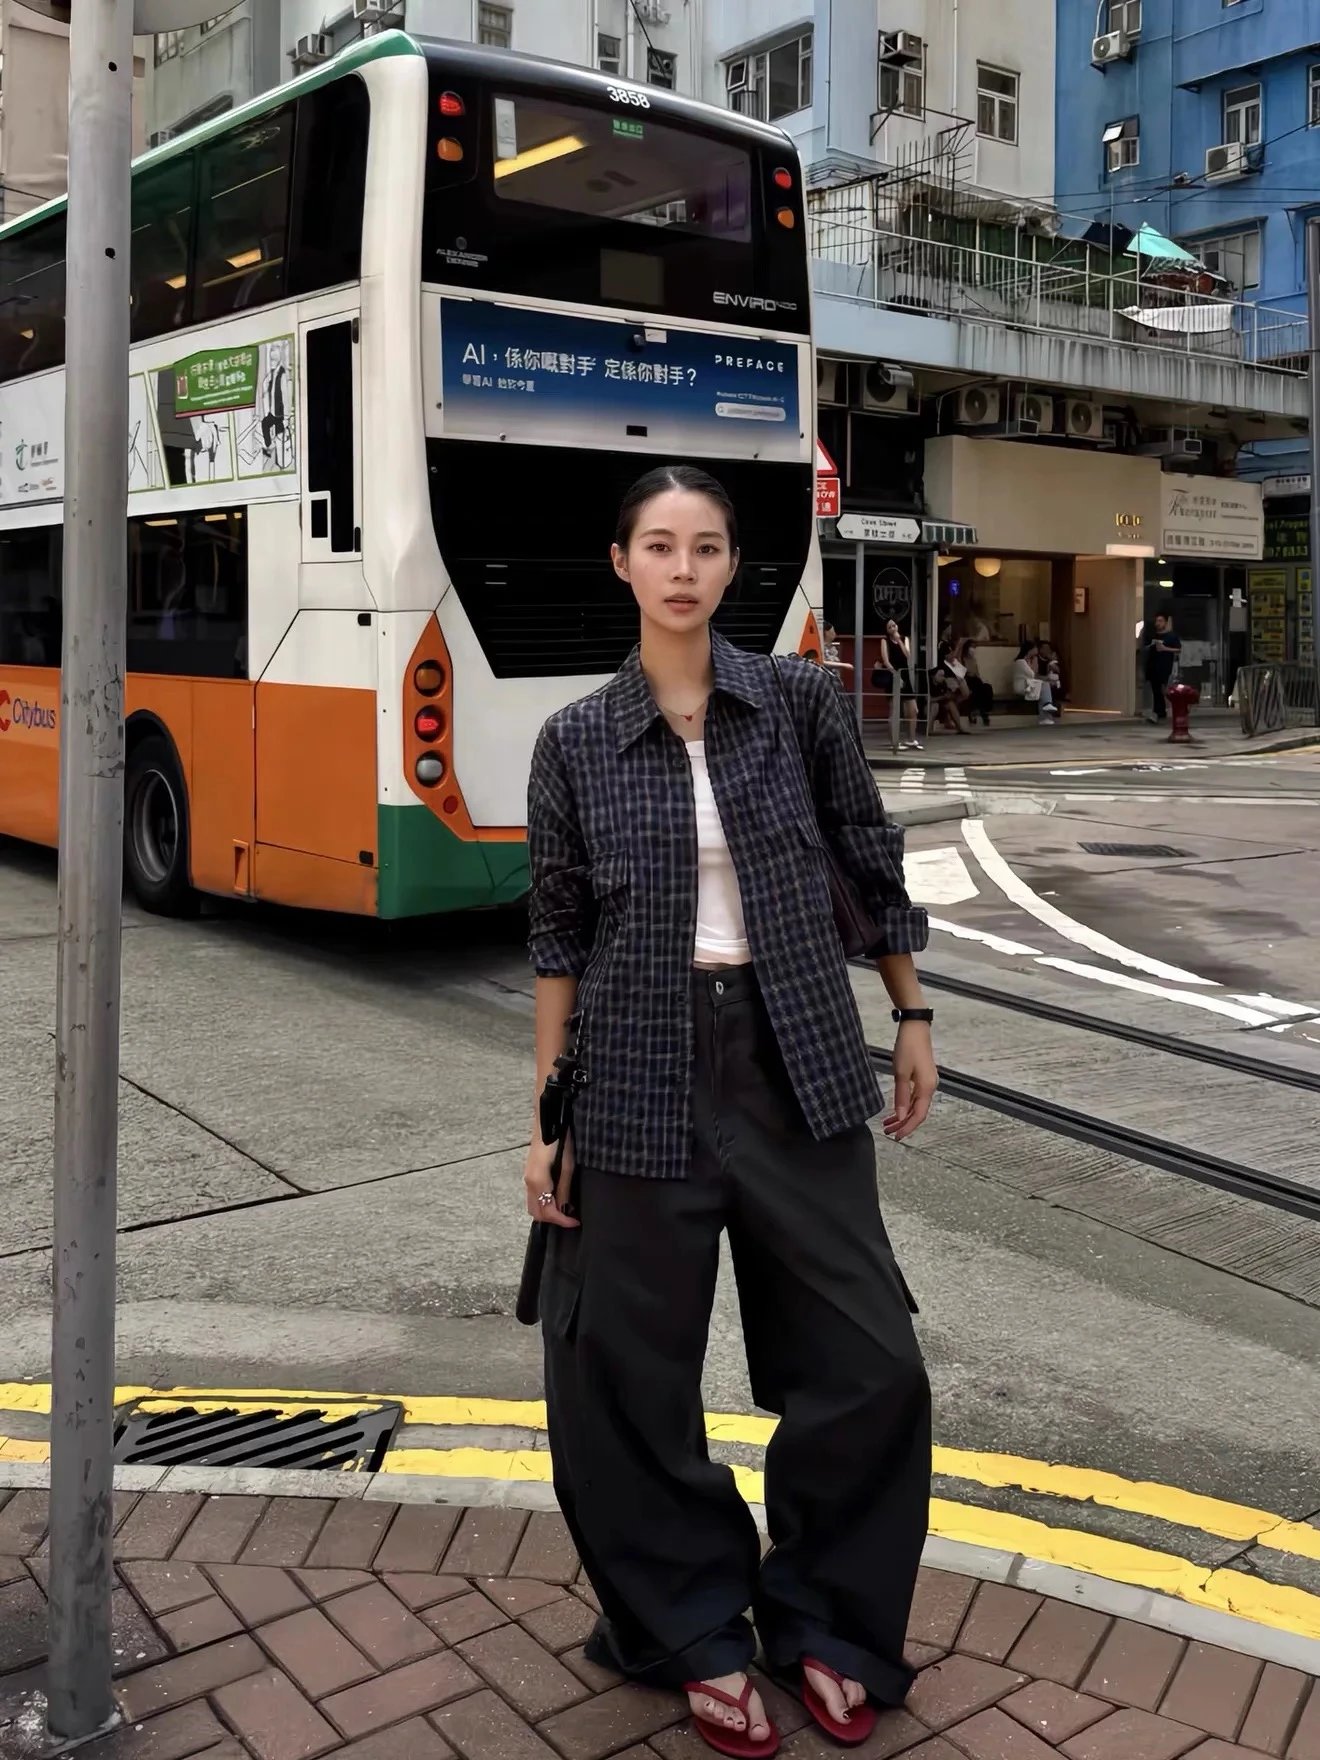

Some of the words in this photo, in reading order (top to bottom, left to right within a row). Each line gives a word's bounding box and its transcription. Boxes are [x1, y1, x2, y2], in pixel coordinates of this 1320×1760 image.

[606, 86, 651, 109] 3858
[715, 354, 784, 373] PREFACE
[13, 697, 57, 730] Citybus
